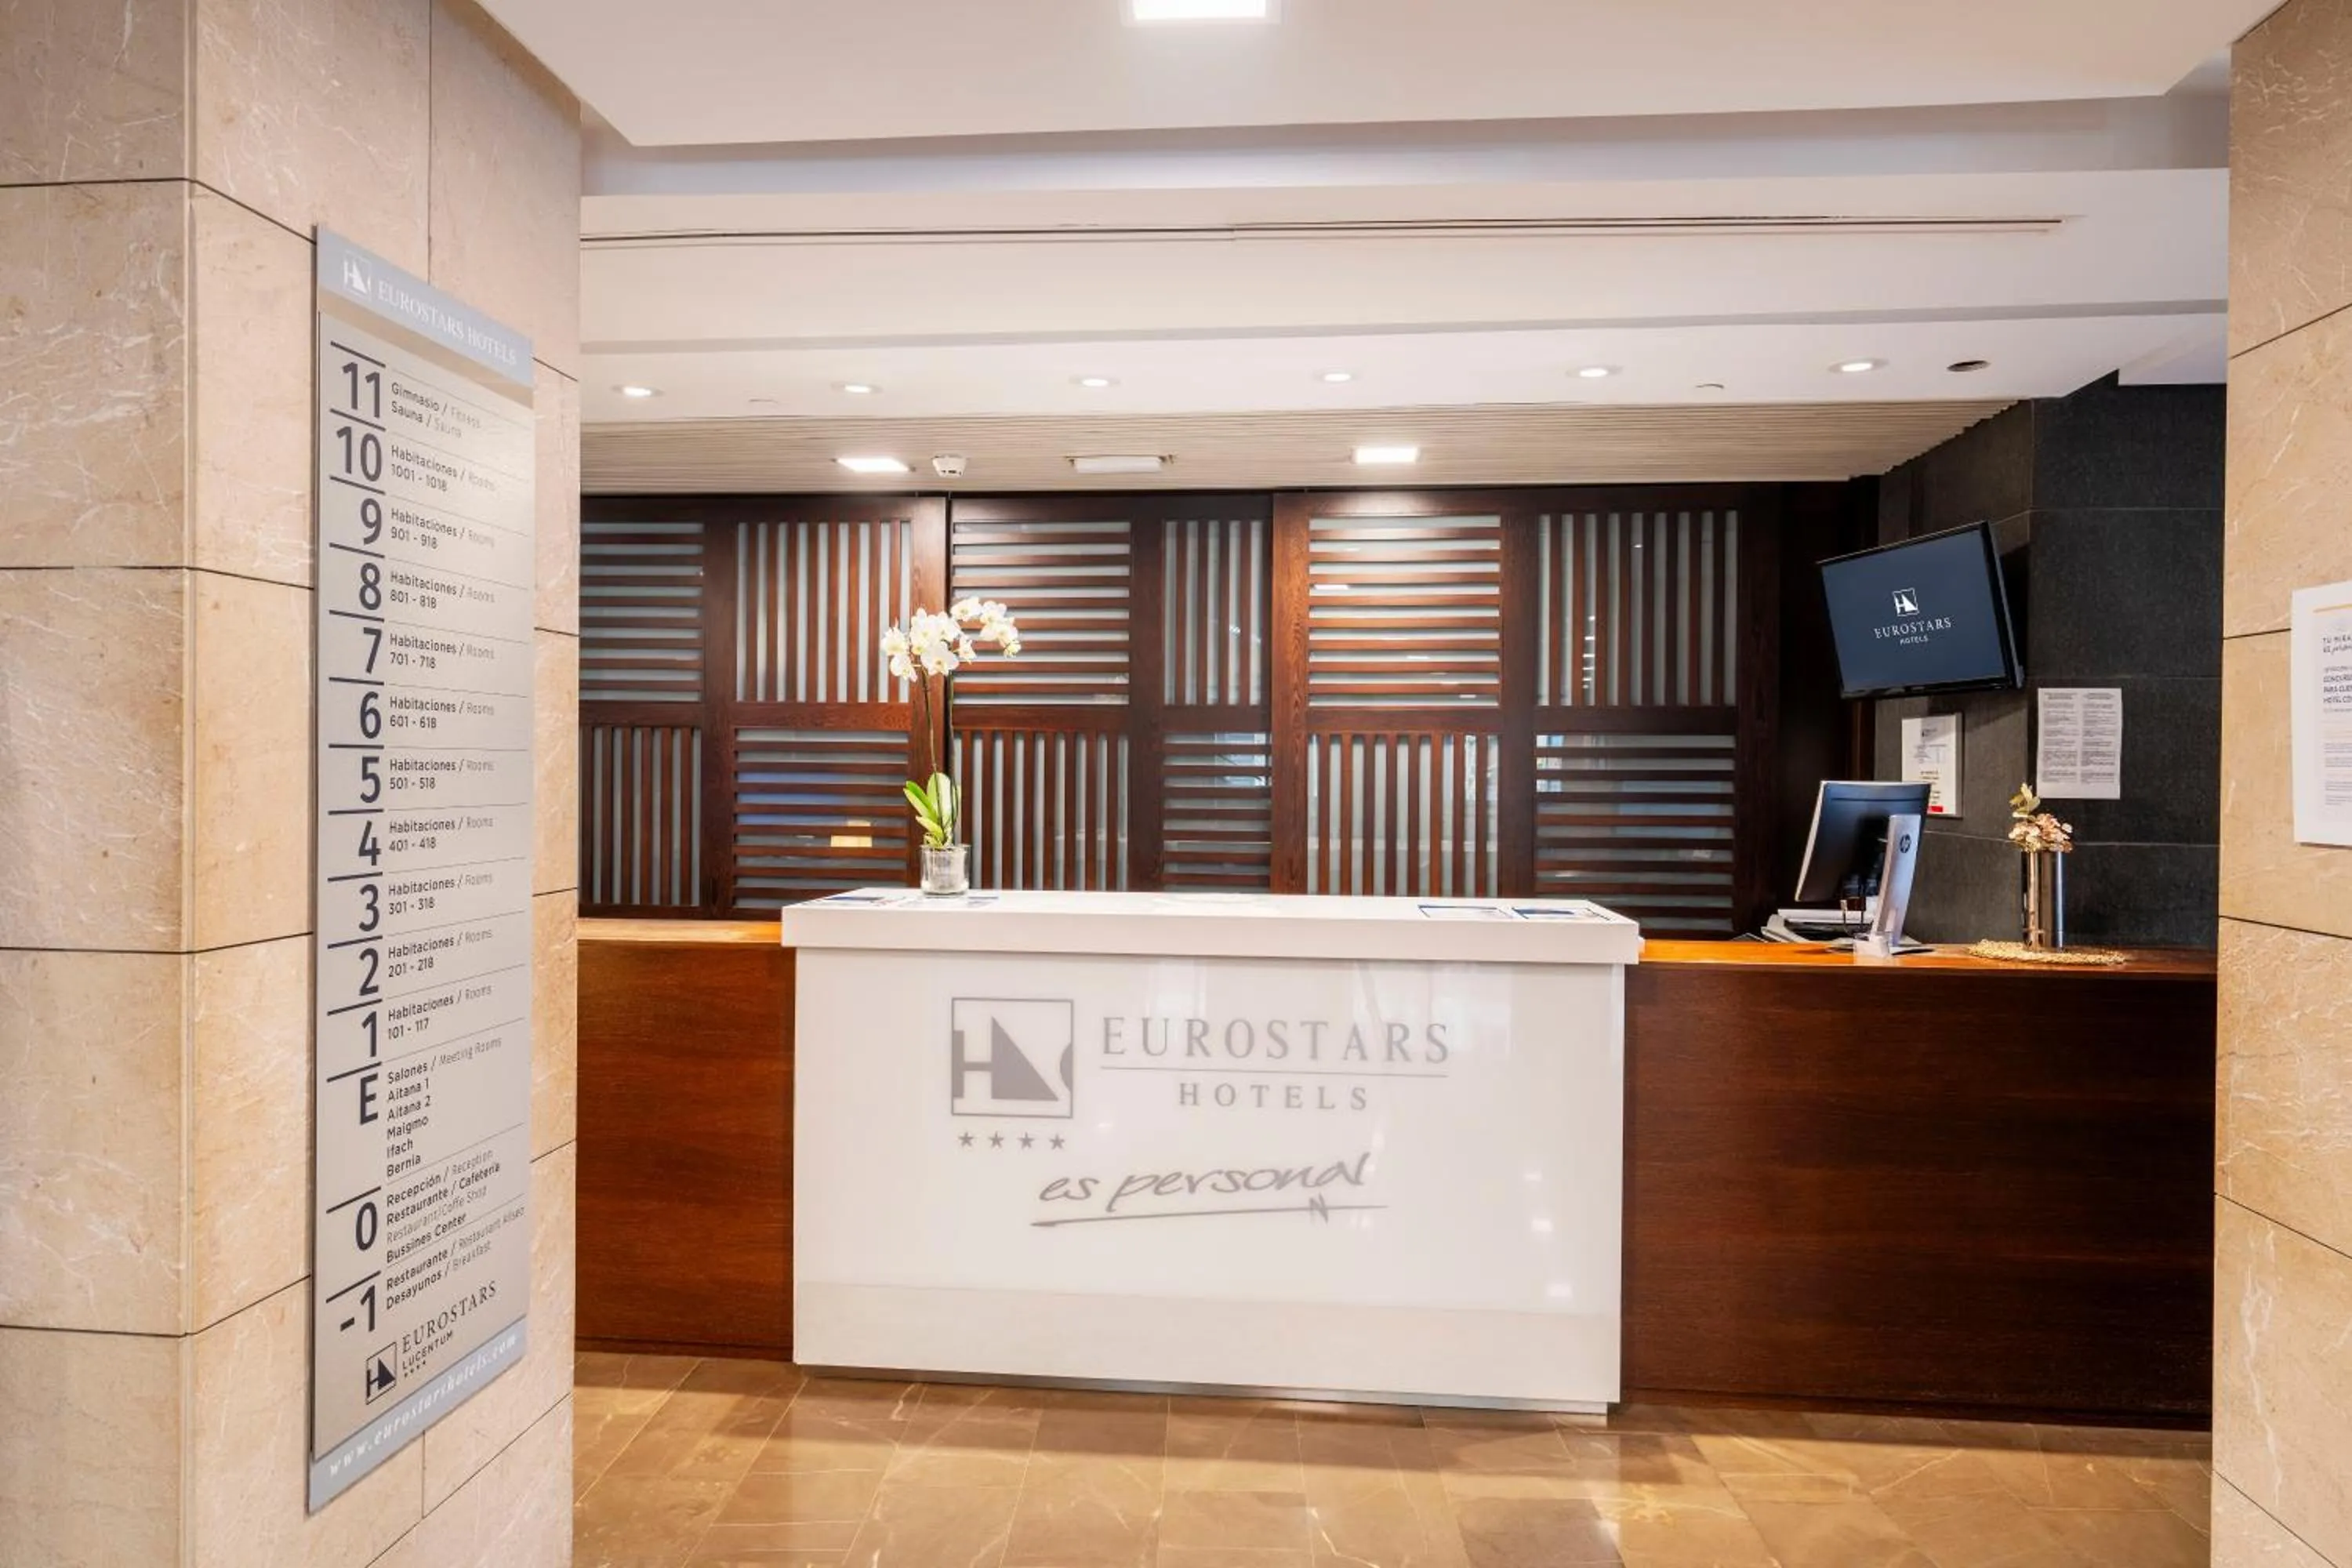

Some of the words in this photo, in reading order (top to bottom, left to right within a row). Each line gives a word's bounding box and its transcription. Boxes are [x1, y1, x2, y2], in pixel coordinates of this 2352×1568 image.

[378, 280, 464, 339] EUROSTARS
[467, 325, 517, 366] HOTELS
[341, 361, 381, 419] 11
[391, 382, 440, 412] Gimnasio
[391, 400, 423, 424] Sauna
[336, 426, 382, 482] 10
[391, 445, 457, 479] Habitaciones
[391, 463, 416, 482] 1001
[425, 474, 448, 492] 1018
[360, 498, 382, 546] 9
[391, 508, 457, 537] Habitaciones
[391, 526, 410, 543] 901
[420, 533, 438, 550] 918
[359, 562, 382, 611] 8
[390, 571, 456, 597] Habitaciones
[390, 589, 409, 604] 801
[419, 595, 437, 609] 818
[1874, 616, 1952, 640] EUROSTARS
[1900, 635, 1929, 645] HOTELS
[363, 626, 382, 674] 7
[390, 633, 457, 655] Habitaciones
[390, 652, 408, 666] 701
[419, 655, 437, 669] 718
[360, 691, 382, 739] 6
[390, 695, 456, 713] Habitaciones
[390, 714, 408, 728] 601
[419, 716, 437, 729] 618
[360, 756, 381, 804] 5
[390, 758, 456, 772] Habitaciones
[390, 777, 408, 789] 501
[419, 777, 436, 789] 518
[389, 818, 456, 833] Habitaciones
[358, 820, 382, 866] 4
[389, 838, 408, 851] 401
[419, 837, 437, 849] 418
[388, 877, 455, 896] Habitaciones
[465, 872, 493, 886] Rooms
[358, 884, 380, 932] 3
[389, 901, 407, 915] 301
[418, 897, 435, 910] 318
[388, 935, 454, 959] Habitaciones
[465, 928, 493, 943] Rooms
[358, 948, 379, 996] 2
[388, 964, 407, 978] 201
[417, 956, 434, 971] 218
[388, 994, 454, 1022] Habitaciones
[465, 985, 492, 1000] Rooms
[361, 1011, 377, 1058] 1
[388, 1024, 404, 1040] 101
[416, 1018, 430, 1033] 117
[1102, 1015, 1450, 1065] EUROSTARS
[387, 1061, 428, 1084] Salones
[438, 1045, 473, 1065] Meeting
[474, 1037, 503, 1055] Rooms
[360, 1073, 379, 1126] E
[387, 1081, 422, 1103] Aitana
[425, 1078, 429, 1090] 1
[1178, 1082, 1367, 1112] HOTELS
[387, 1099, 422, 1122] Aitana
[424, 1095, 431, 1107] 2
[387, 1116, 429, 1140] Maigmo
[387, 1138, 413, 1159] Ifach
[387, 1154, 421, 1178] Bernia
[1039, 1174, 1100, 1202] es
[1105, 1152, 1371, 1213] personal
[387, 1189, 448, 1226] Restaurante
[356, 1201, 378, 1251] 0
[387, 1231, 432, 1264] Bussines
[434, 1213, 467, 1237] Center
[387, 1249, 448, 1291] Restaurante
[387, 1270, 442, 1310] Desayunos
[339, 1284, 376, 1333] -1
[401, 1280, 498, 1354] EUROSTARS
[402, 1331, 454, 1370] LUCENTUM
[329, 1334, 517, 1478] www.eurostarshotels.com
